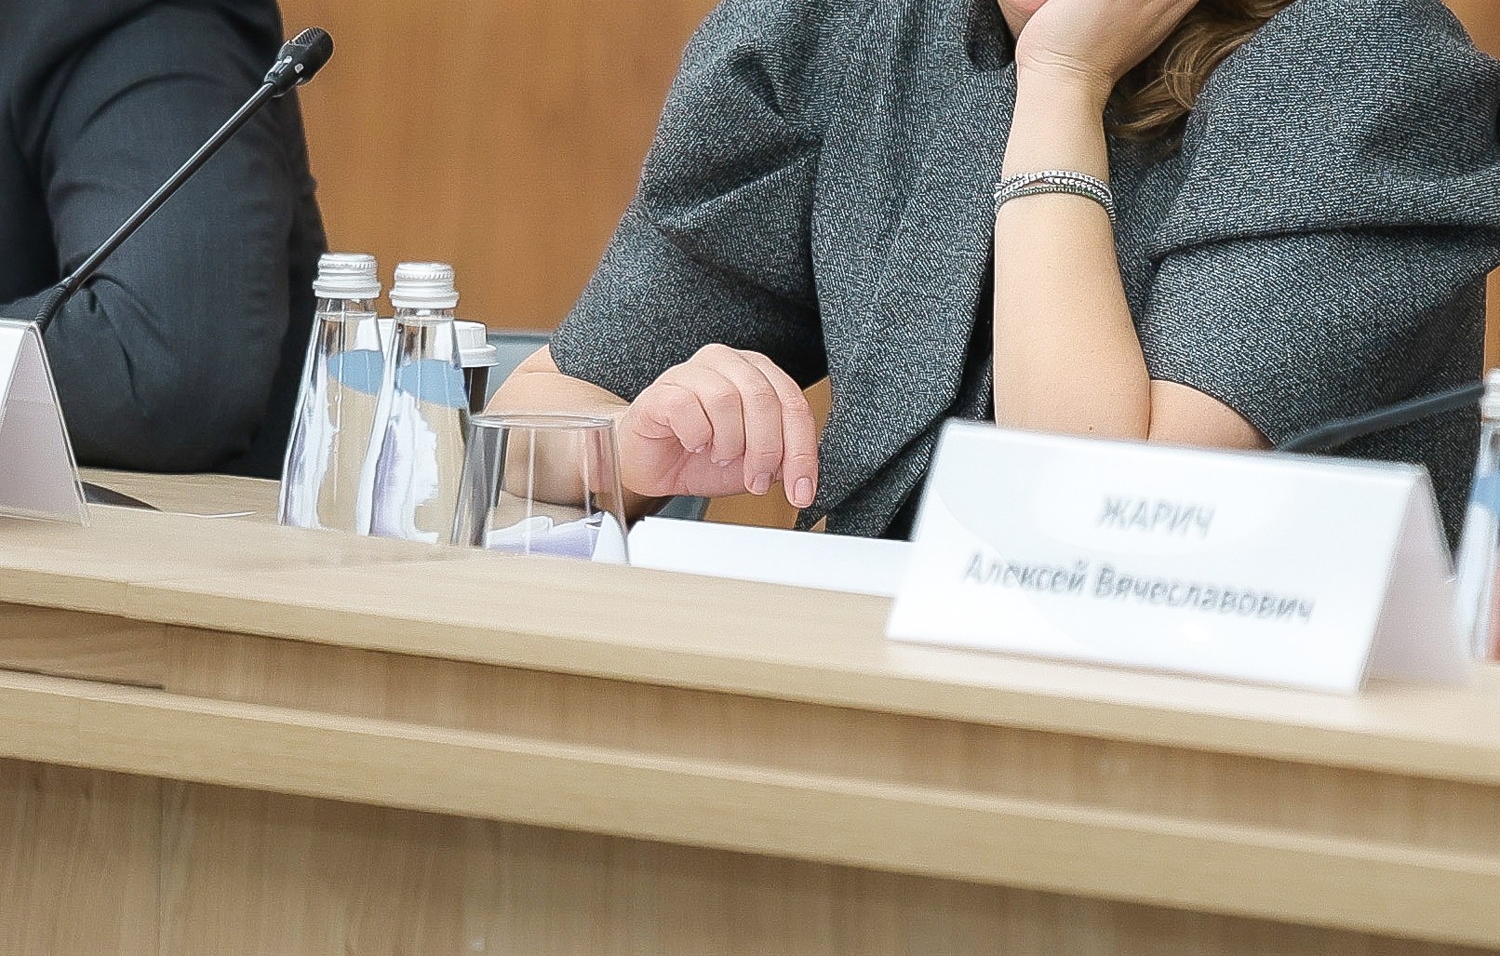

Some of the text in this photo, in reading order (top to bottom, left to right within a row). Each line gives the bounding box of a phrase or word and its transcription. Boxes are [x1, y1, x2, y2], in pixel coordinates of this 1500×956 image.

[1096, 493, 1216, 539] ЖАРИЧ
[961, 548, 1316, 623] Алексей Вячеславович
